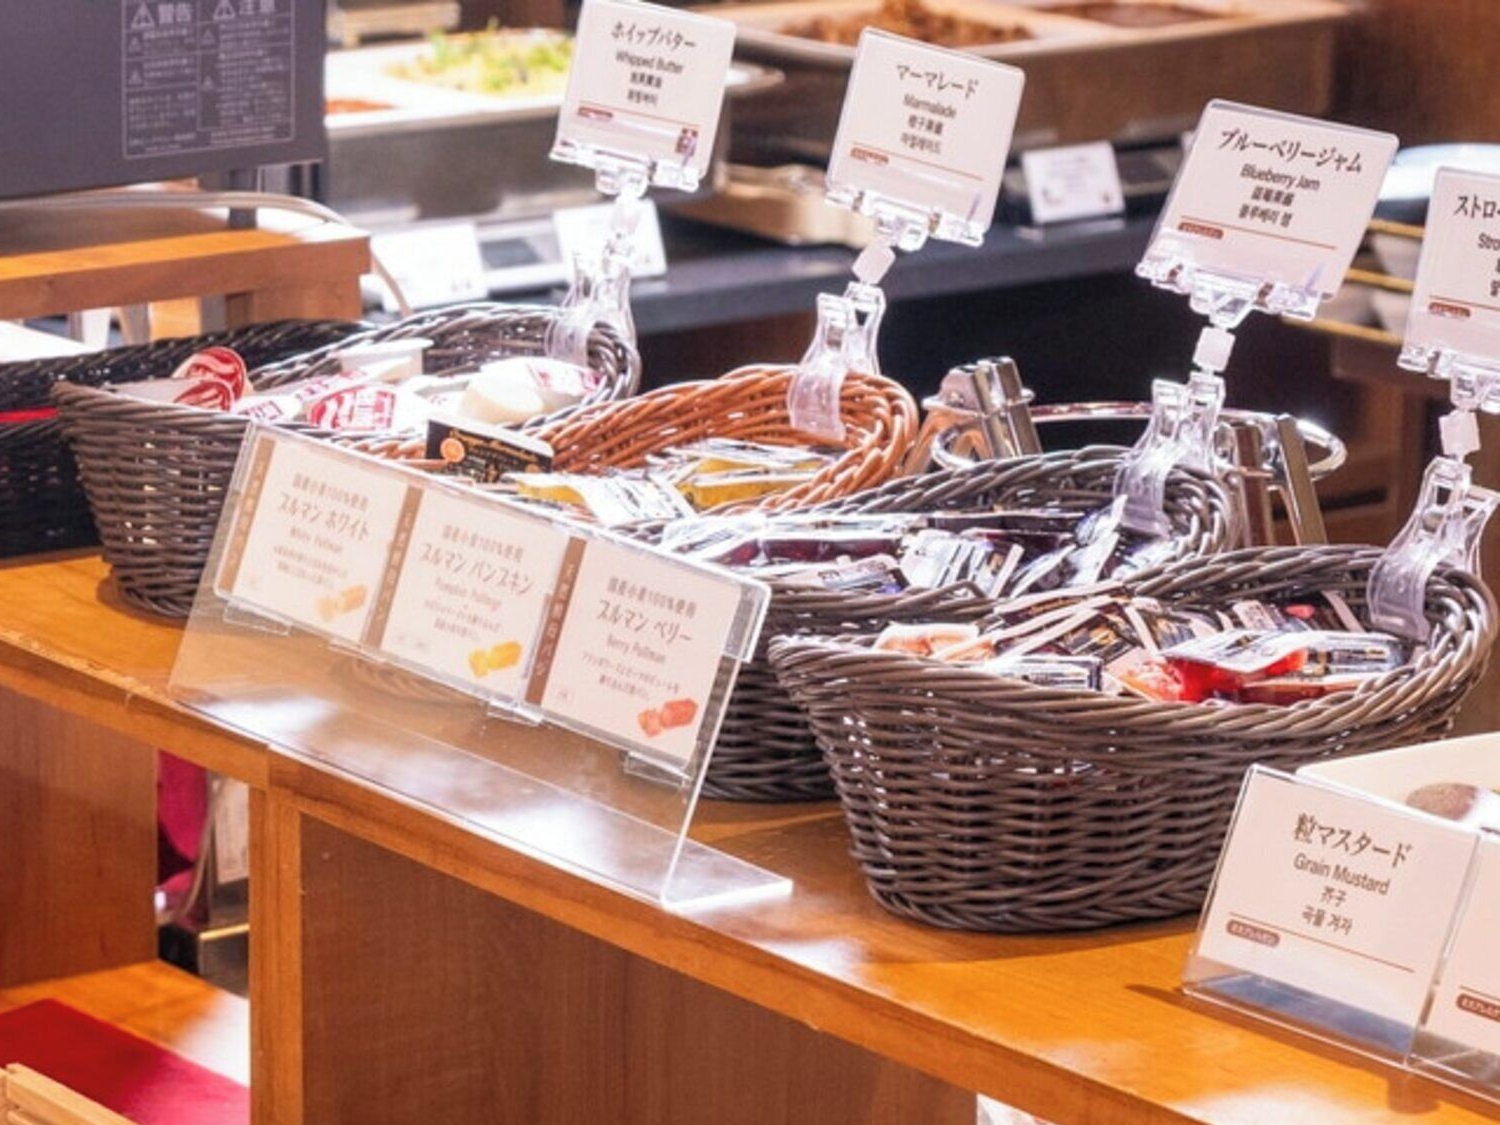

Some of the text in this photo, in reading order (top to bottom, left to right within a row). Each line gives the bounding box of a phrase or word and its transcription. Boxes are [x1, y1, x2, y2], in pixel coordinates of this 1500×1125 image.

[612, 20, 697, 50] ホイップバター
[896, 64, 979, 100] マーマレード
[902, 93, 957, 119] Marmalade
[1218, 128, 1362, 173] ブルーベリージャム
[1240, 163, 1321, 191] Blueberry Jam
[1293, 812, 1413, 868] 粒マスタード
[1293, 852, 1391, 896] Grain Mustard
[1320, 887, 1348, 906] 芥子
